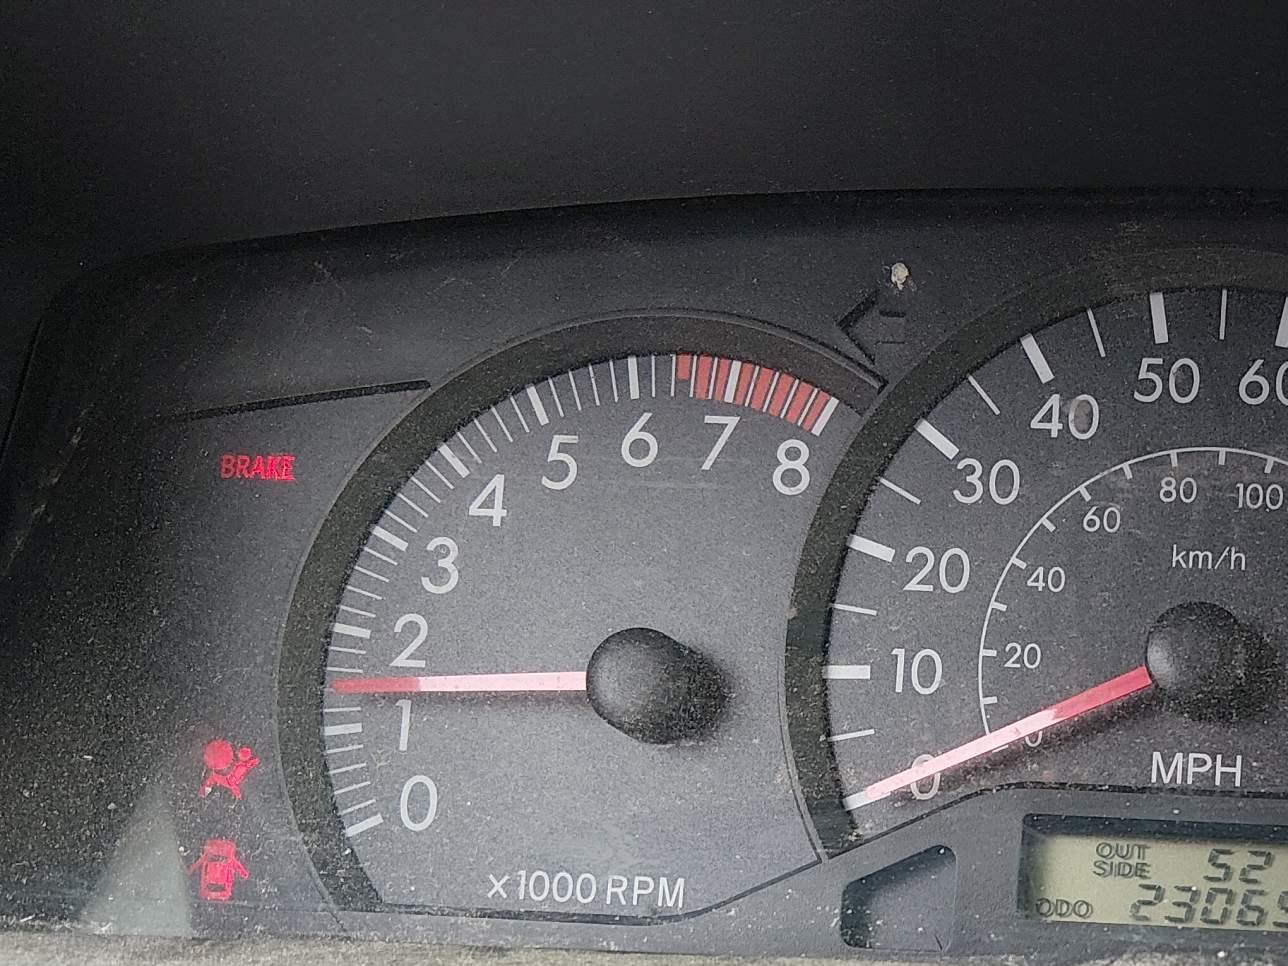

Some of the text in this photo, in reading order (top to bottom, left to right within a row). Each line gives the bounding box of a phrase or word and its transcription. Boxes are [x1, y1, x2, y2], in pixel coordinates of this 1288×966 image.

[1134, 358, 1200, 404] 50
[621, 412, 658, 468] 6
[1030, 394, 1100, 440] 40
[541, 434, 579, 490] 5
[701, 415, 740, 471] 7
[220, 454, 296, 481] BRAKE
[772, 439, 811, 496] 8
[953, 457, 1020, 505] 30
[1159, 476, 1197, 504] 80
[468, 473, 508, 527] 4
[1083, 506, 1121, 534] 60
[1236, 483, 1284, 511] 100
[421, 536, 459, 594] 3
[903, 546, 970, 594] 20
[1026, 566, 1066, 593] 40
[1171, 546, 1247, 572] km/h
[389, 613, 427, 668] 2
[1004, 642, 1041, 670] 20
[891, 648, 943, 695] 10
[398, 700, 412, 751] 1
[1151, 752, 1242, 787] MPH
[399, 774, 438, 832] 0
[1092, 859, 1151, 879] SIDE
[1096, 842, 1150, 860] OUT
[1203, 848, 1275, 884] 52
[606, 875, 686, 910] RPM
[1035, 898, 1093, 919] ODO
